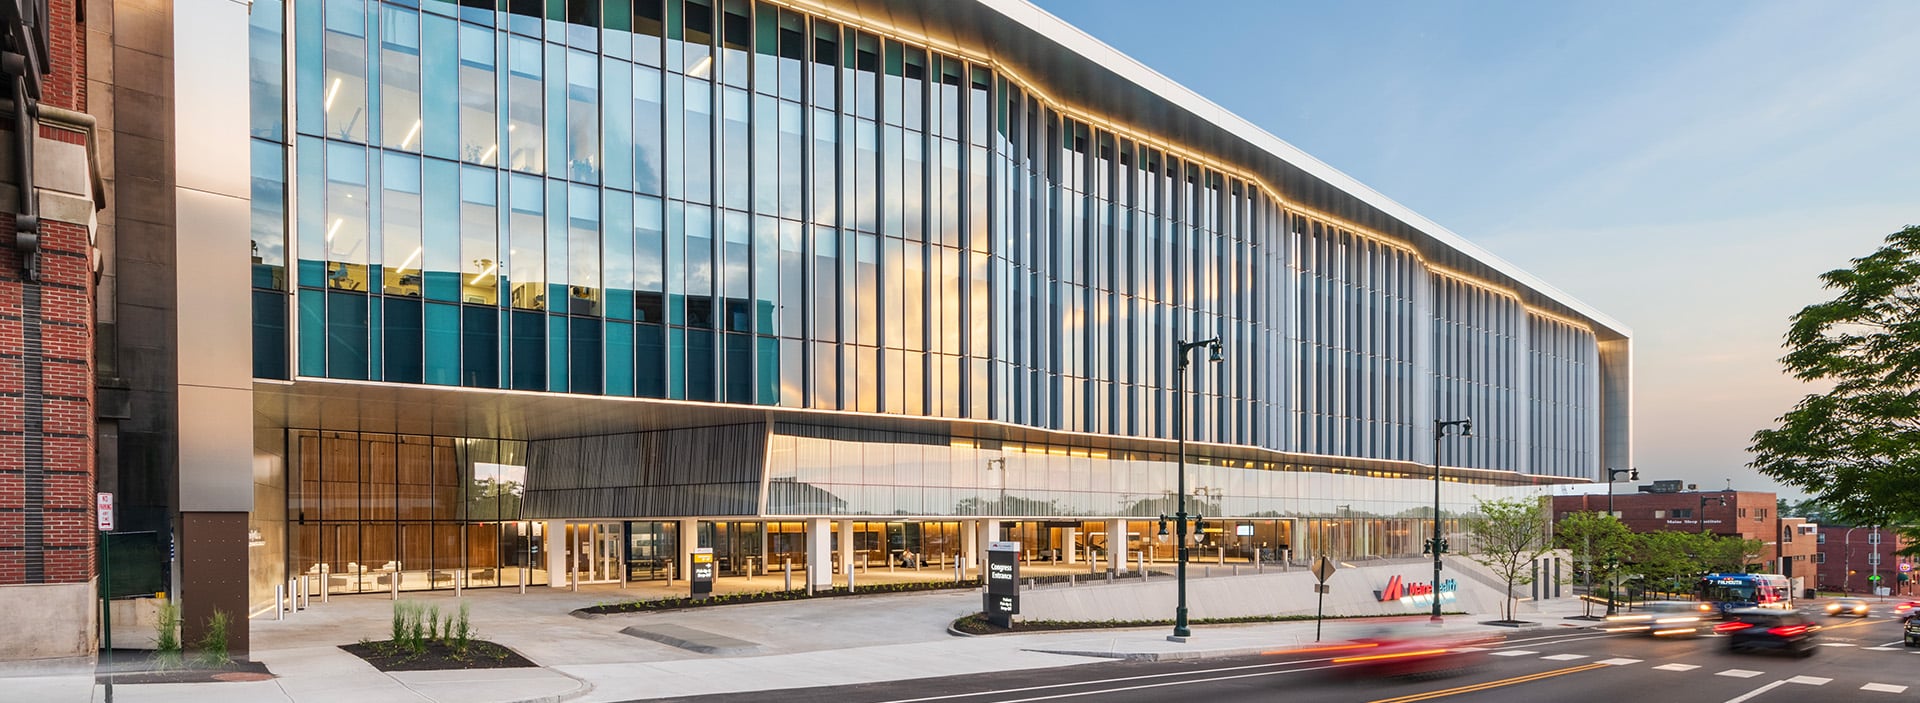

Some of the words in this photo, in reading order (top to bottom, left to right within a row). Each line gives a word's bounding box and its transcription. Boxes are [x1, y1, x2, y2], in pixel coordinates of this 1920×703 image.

[991, 563, 1012, 572] Congress
[992, 572, 1012, 580] Entrance
[1408, 578, 1457, 596] Maineealth
